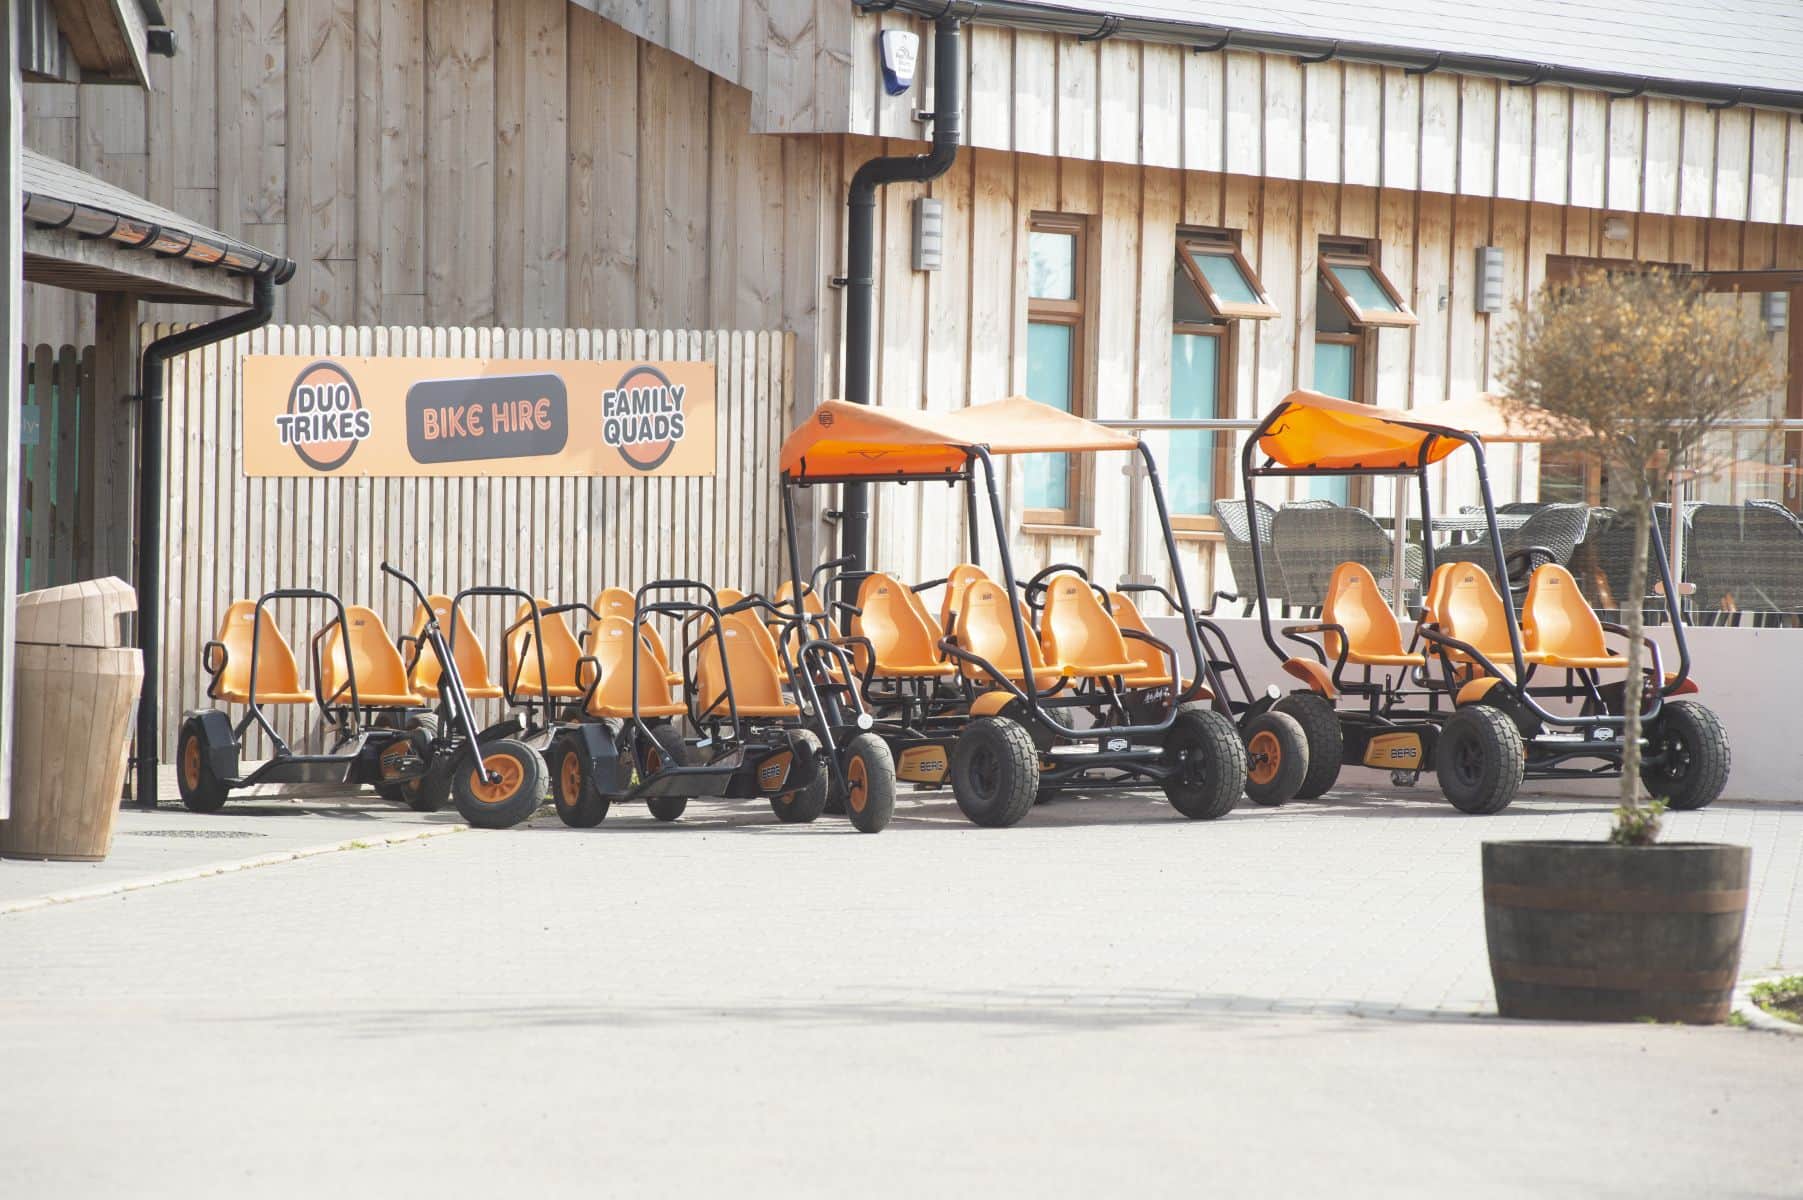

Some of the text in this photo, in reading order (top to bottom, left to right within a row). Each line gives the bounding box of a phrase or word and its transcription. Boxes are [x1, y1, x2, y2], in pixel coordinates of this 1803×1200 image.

[298, 383, 350, 414] DUO
[603, 386, 685, 418] FAMILY
[276, 411, 370, 443] TRIKES
[423, 398, 552, 440] BIKE HIRE
[604, 413, 684, 445] QUADS
[1390, 747, 1417, 759] BERG
